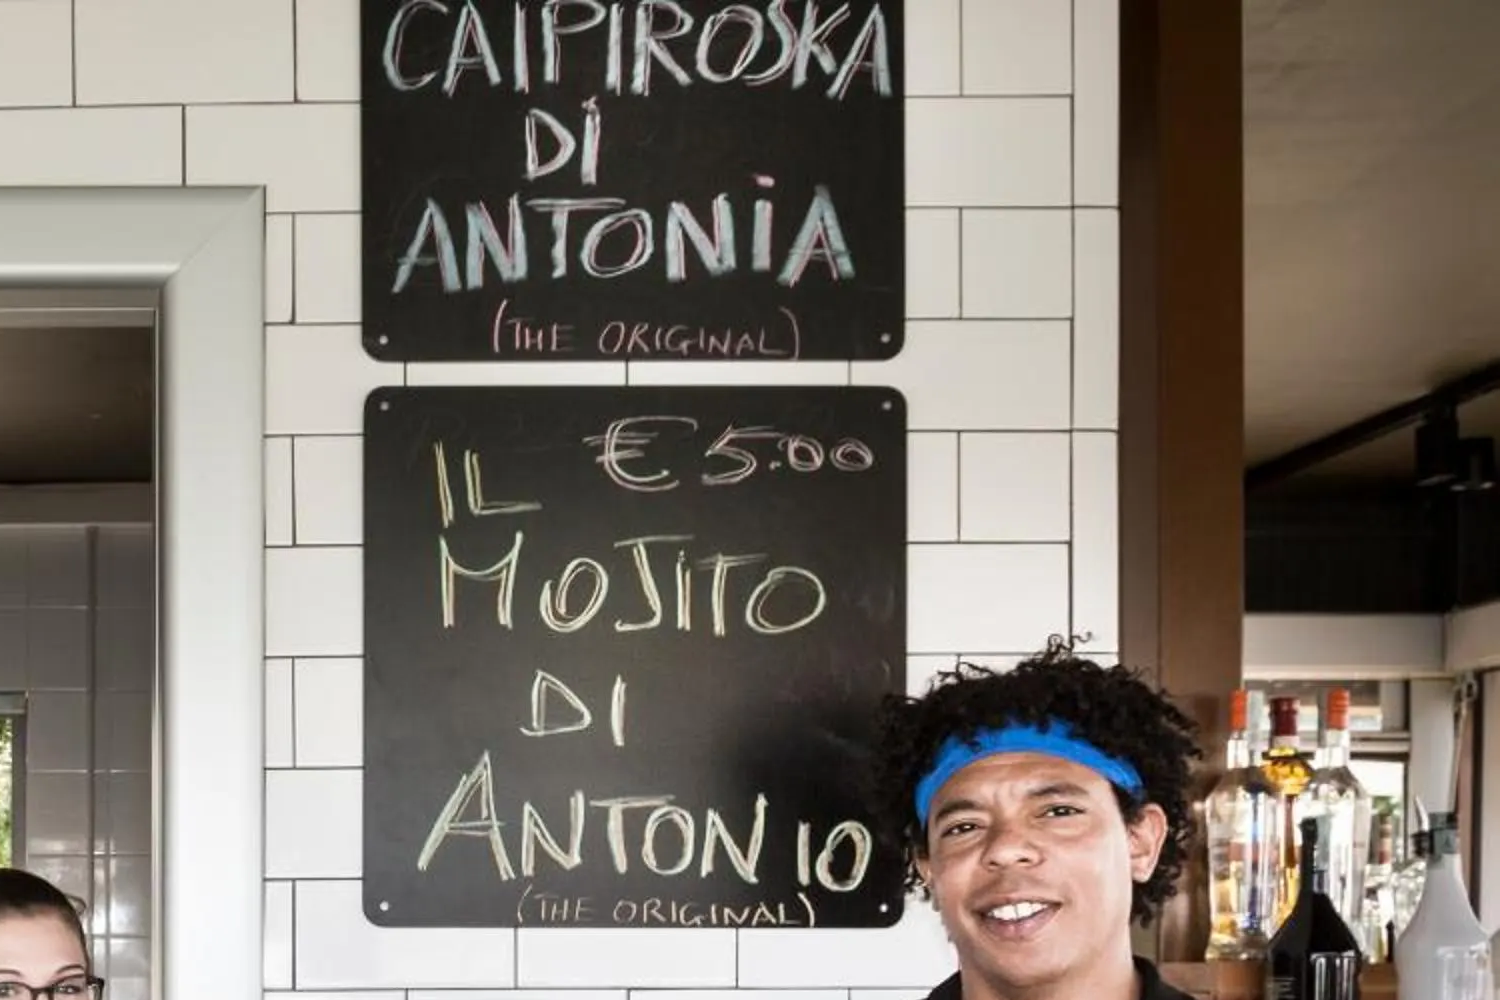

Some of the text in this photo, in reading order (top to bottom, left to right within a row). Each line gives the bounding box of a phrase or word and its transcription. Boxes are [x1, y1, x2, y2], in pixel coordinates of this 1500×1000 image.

[382, 0, 893, 99] CAIPIROSKA
[494, 300, 799, 360] (THE ORIGINAL)
[434, 441, 542, 527] IL
[520, 669, 626, 747] DI
[517, 883, 817, 927] (THE ORIGINAL)
